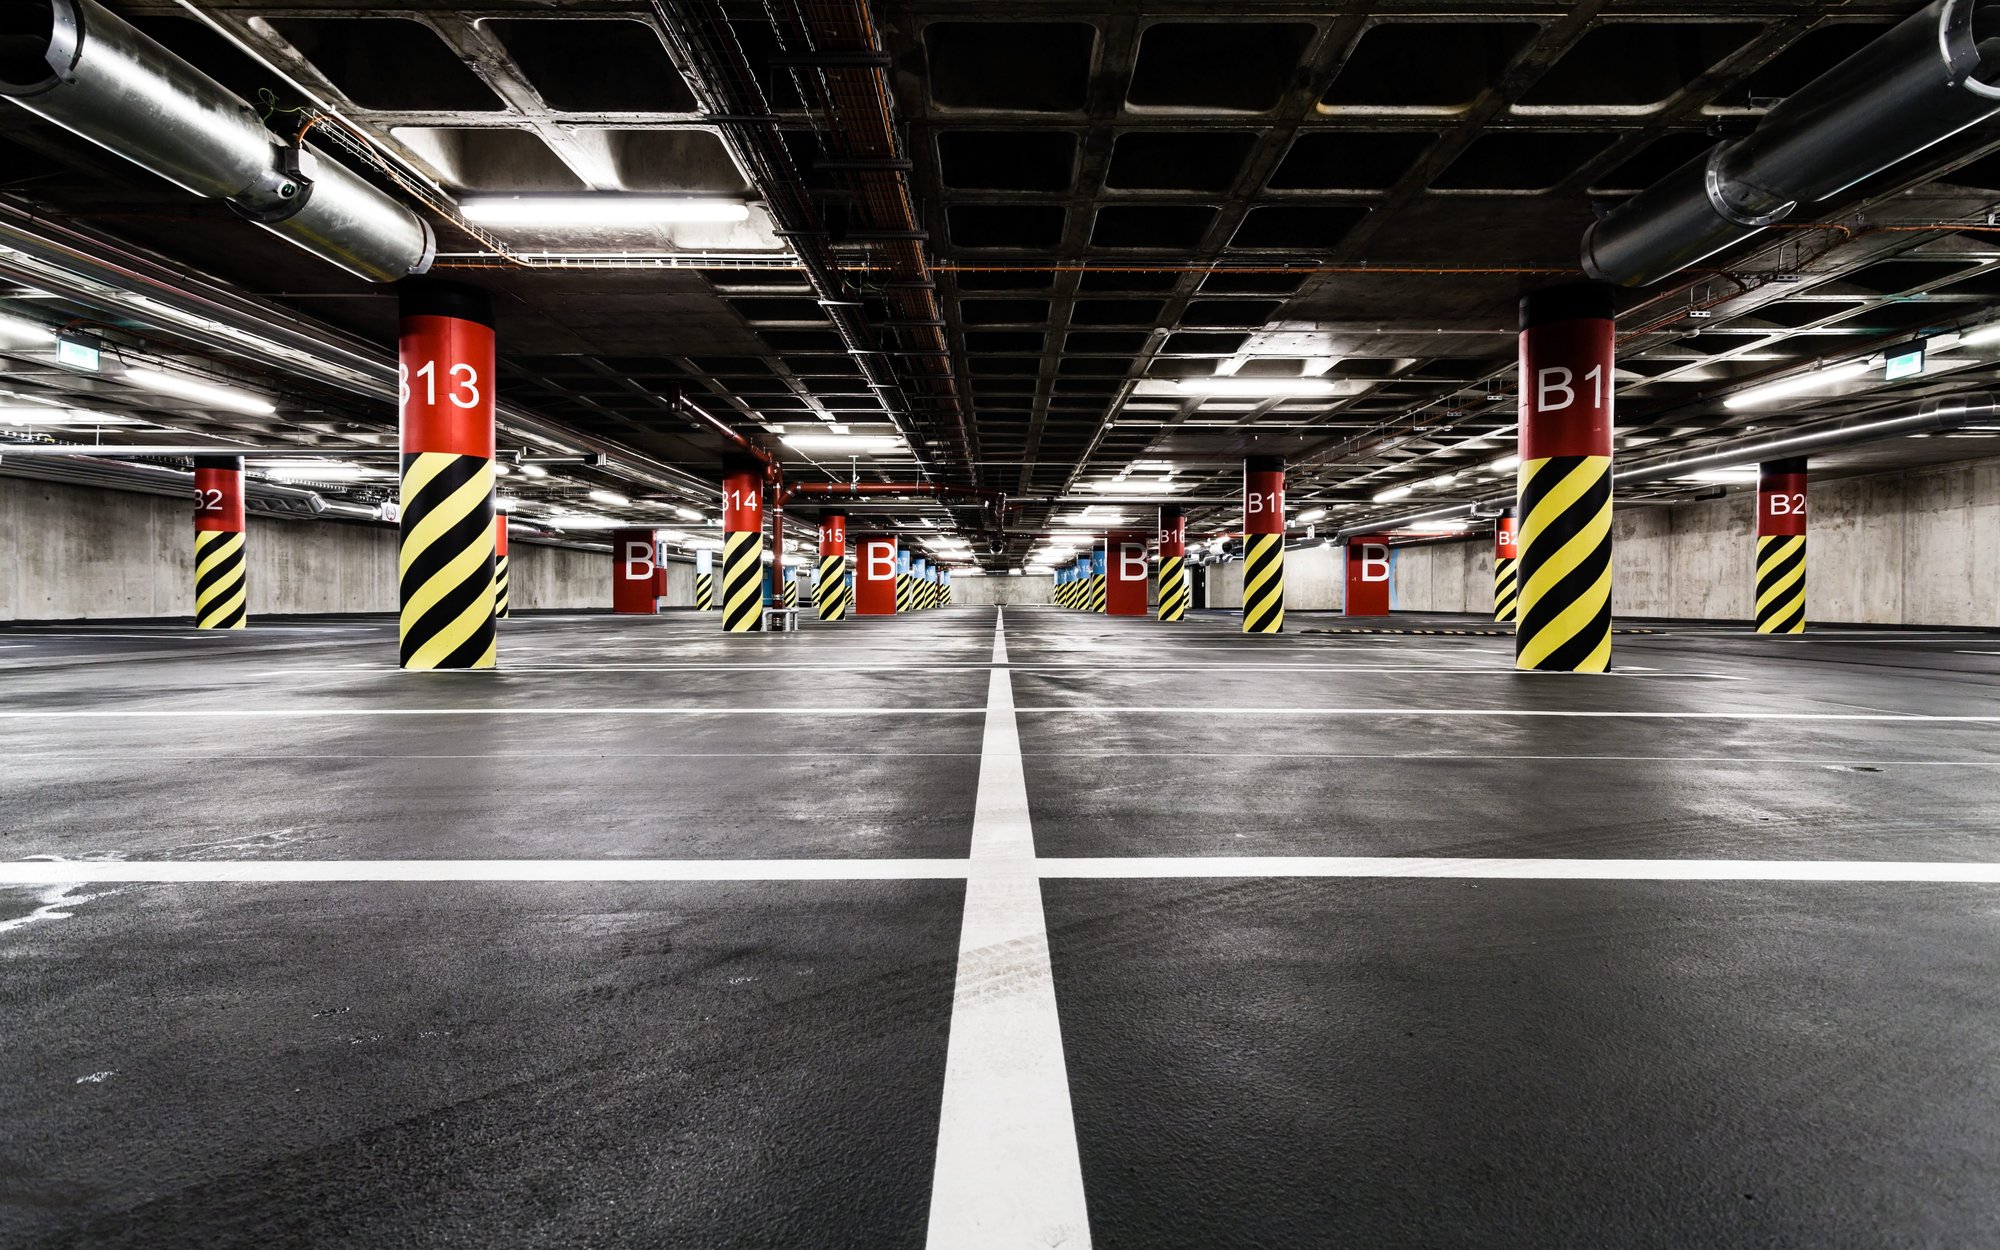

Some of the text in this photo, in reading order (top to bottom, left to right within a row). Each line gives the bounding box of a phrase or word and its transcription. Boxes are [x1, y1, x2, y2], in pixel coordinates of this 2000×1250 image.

[1538, 364, 1603, 413] B1
[1771, 493, 1807, 516] B2
[626, 541, 654, 580] B
[867, 541, 896, 581] B
[1120, 542, 1148, 581] B
[1362, 543, 1390, 582] B
